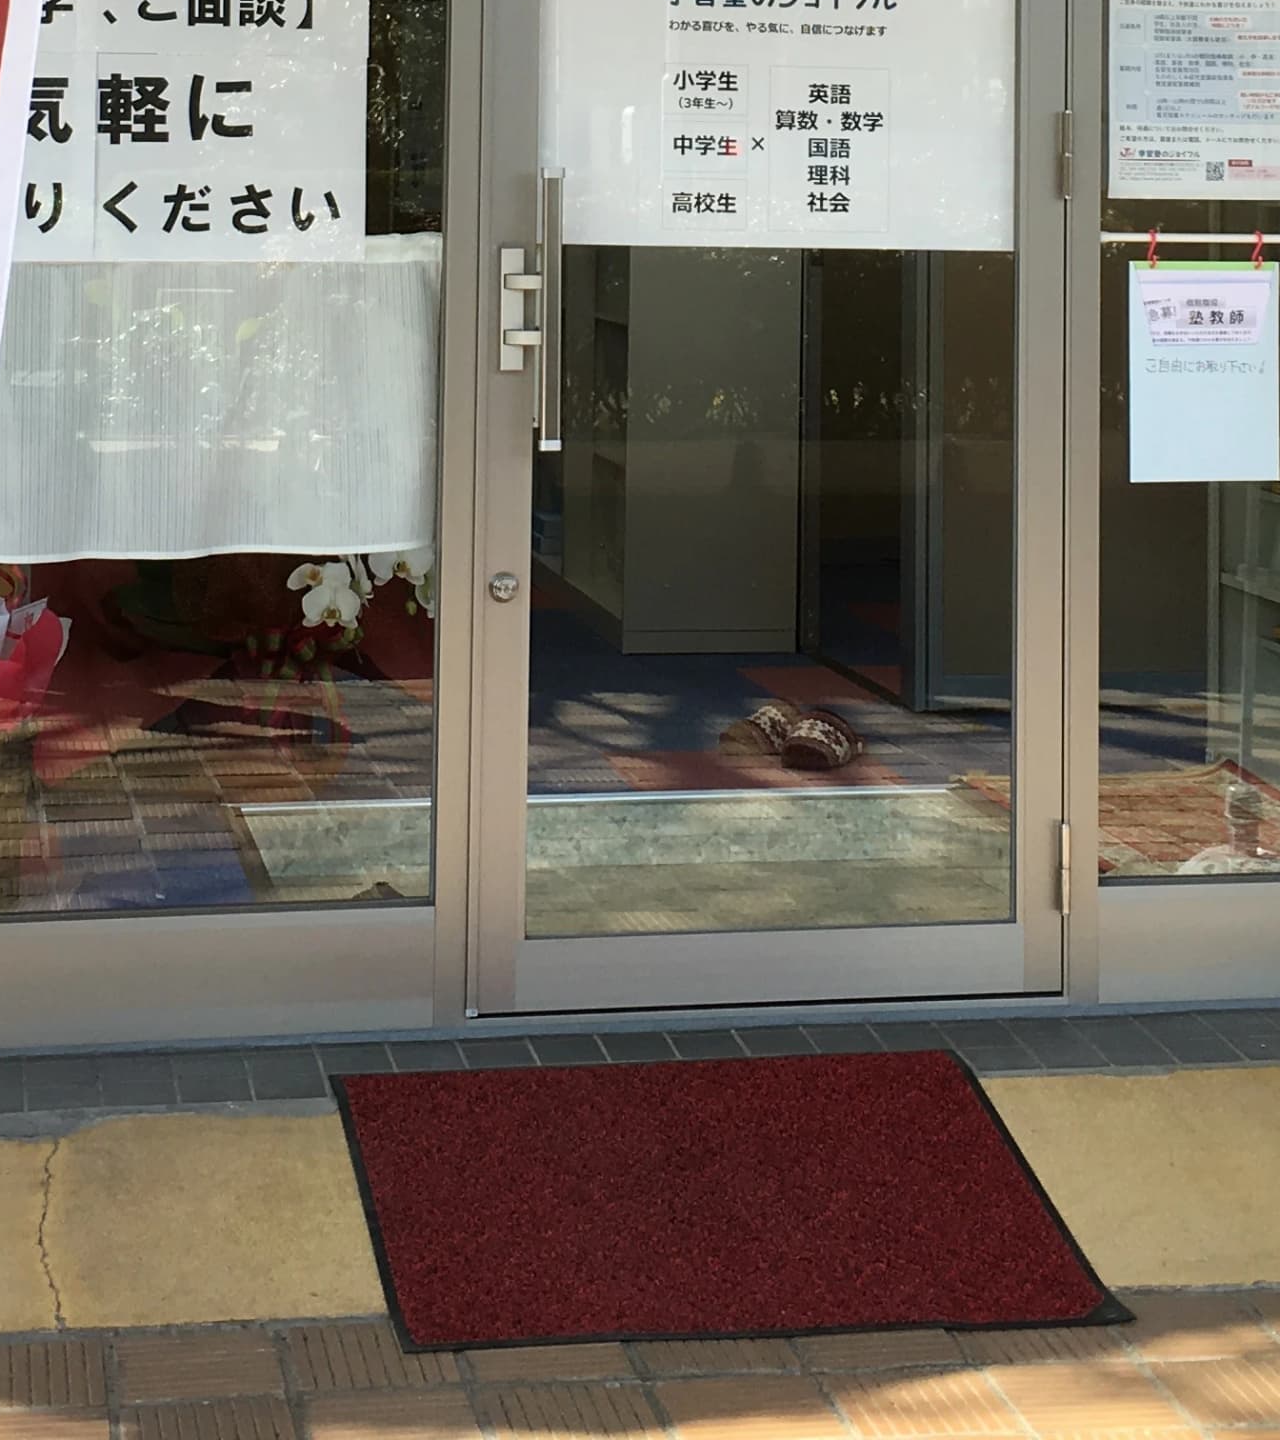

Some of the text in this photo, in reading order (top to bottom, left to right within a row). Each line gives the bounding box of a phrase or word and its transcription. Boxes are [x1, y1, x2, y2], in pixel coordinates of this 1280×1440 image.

[669, 19, 888, 37] わかる喜びを、やる気に、自信につなげます
[673, 69, 739, 92] 小学生
[808, 83, 852, 105] 英語
[775, 109, 884, 133] 算数・数学
[673, 135, 738, 156] 中学生
[808, 138, 851, 159] 国語
[807, 165, 851, 186] 理科
[25, 180, 341, 234] りください
[671, 192, 737, 214] 高校生
[807, 192, 851, 213] 社会
[1188, 310, 1245, 325] 塾教師
